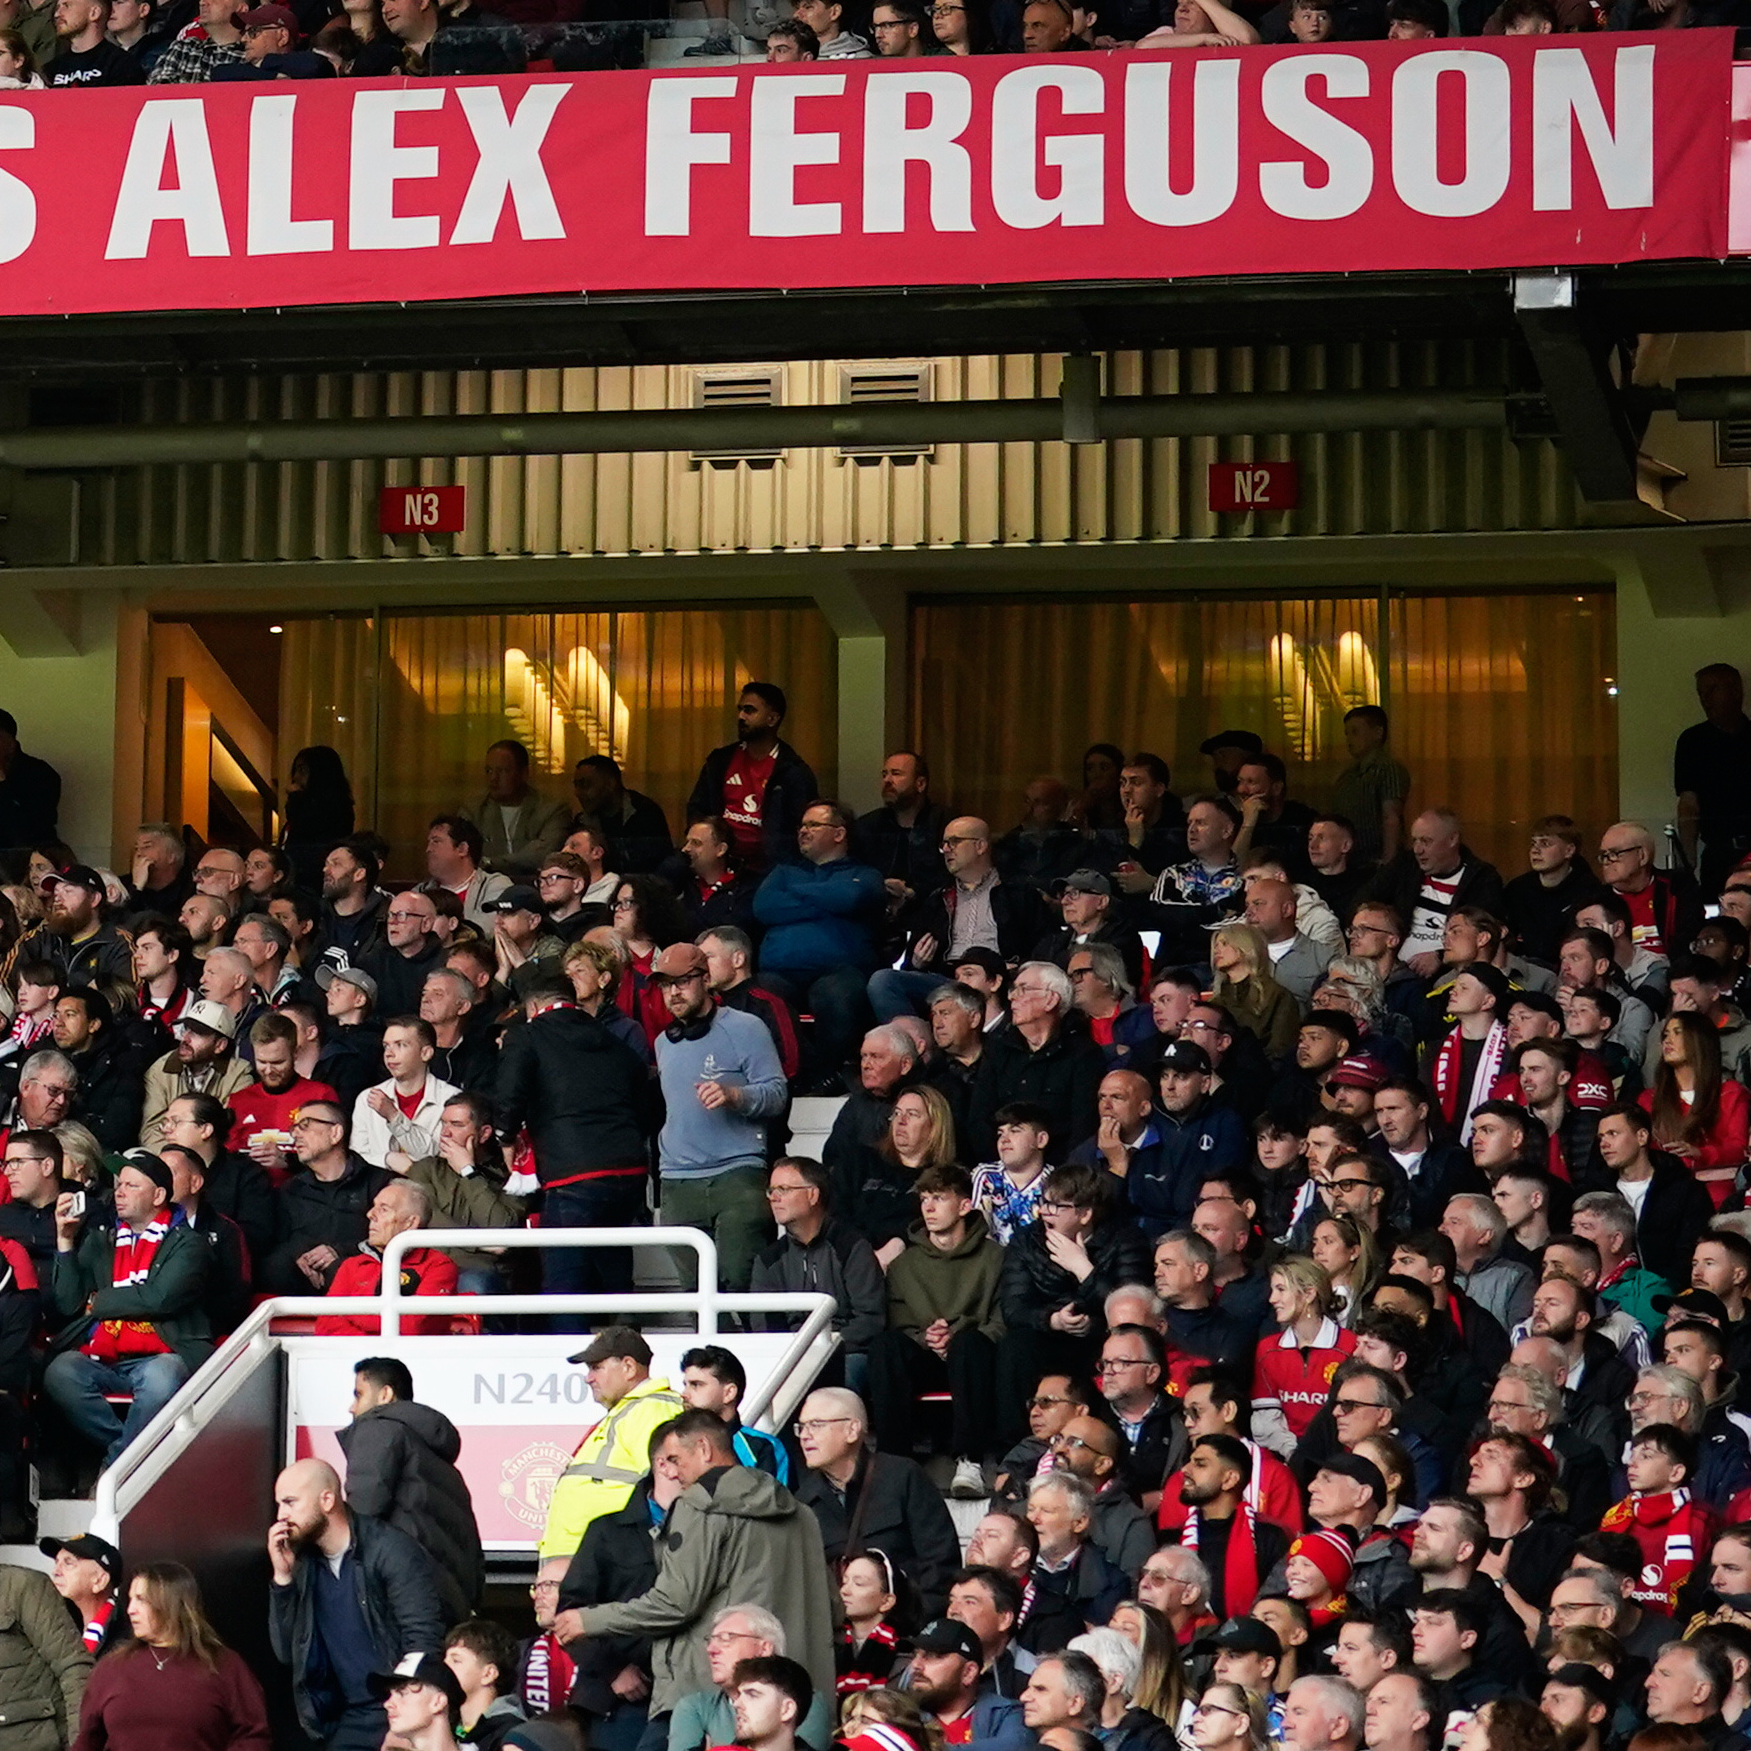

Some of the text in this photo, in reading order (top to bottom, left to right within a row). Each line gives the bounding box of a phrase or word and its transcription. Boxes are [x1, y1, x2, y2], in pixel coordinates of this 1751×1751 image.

[53, 69, 103, 86] SHARP
[104, 82, 574, 260] ALEX
[645, 45, 1656, 238] FERGUSON
[1234, 469, 1270, 503] N2
[404, 493, 439, 526] N3
[1577, 1083, 1608, 1098] DXC
[473, 1372, 589, 1405] N240
